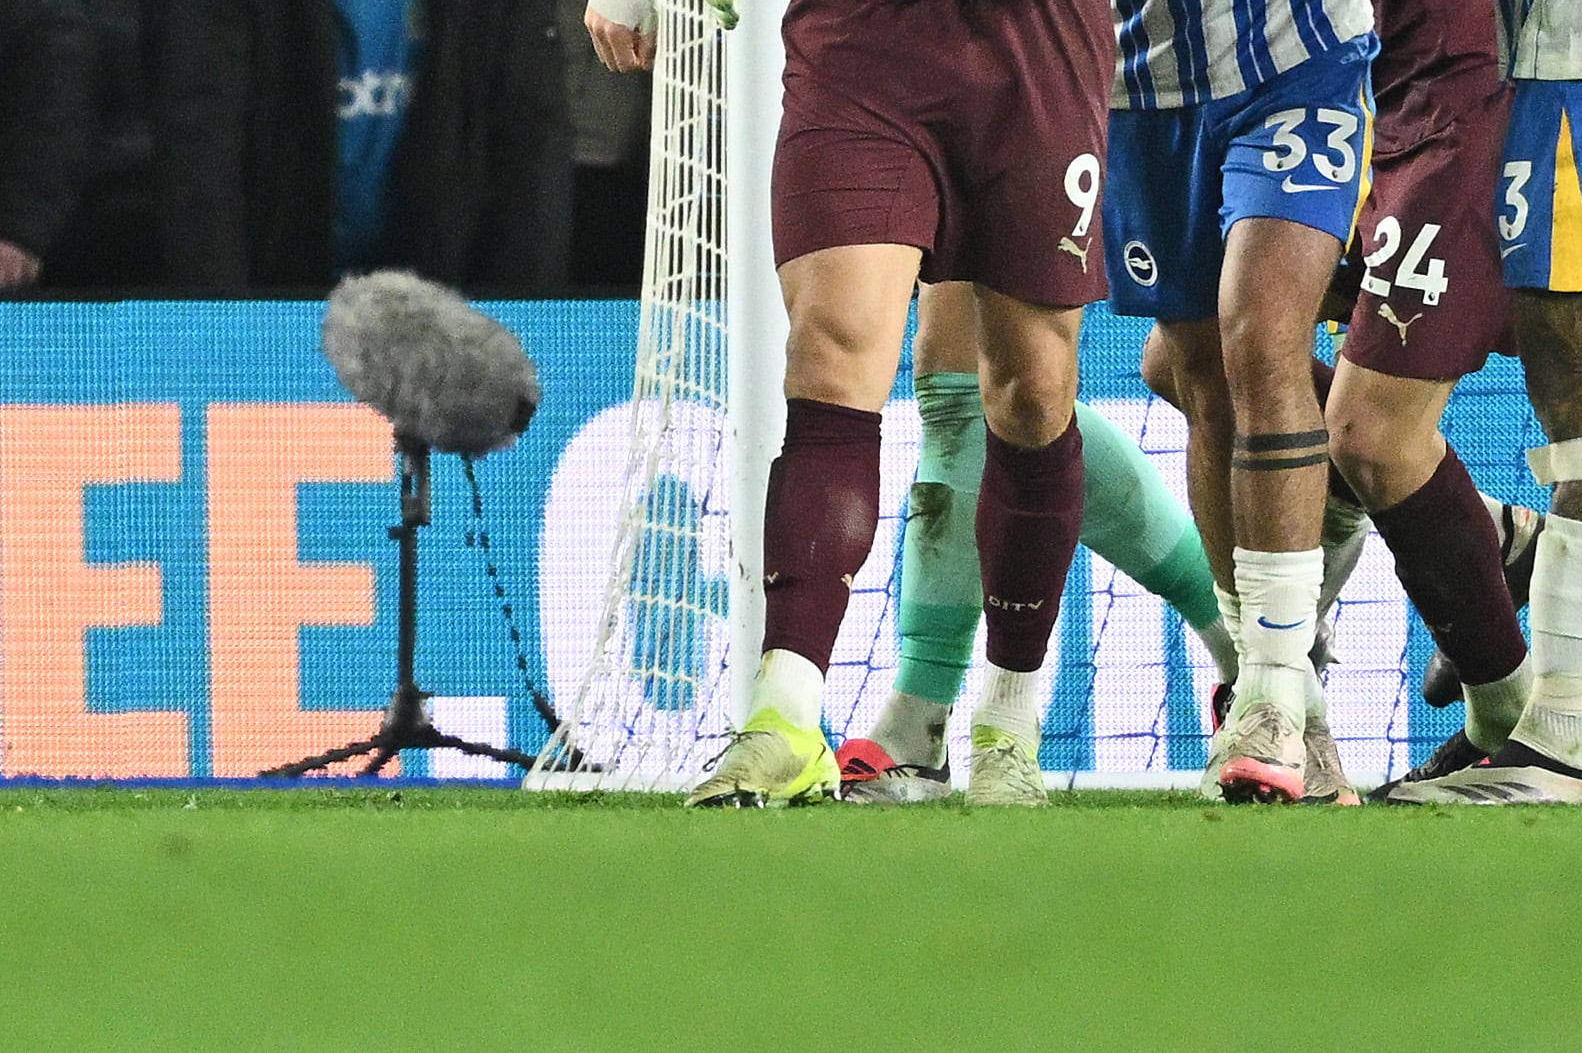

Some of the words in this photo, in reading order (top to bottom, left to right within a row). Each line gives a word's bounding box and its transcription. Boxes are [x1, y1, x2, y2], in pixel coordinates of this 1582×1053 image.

[1263, 108, 1358, 183] 33
[1063, 153, 1100, 236] 9
[1499, 161, 1532, 241] 3
[1360, 216, 1449, 306] 24
